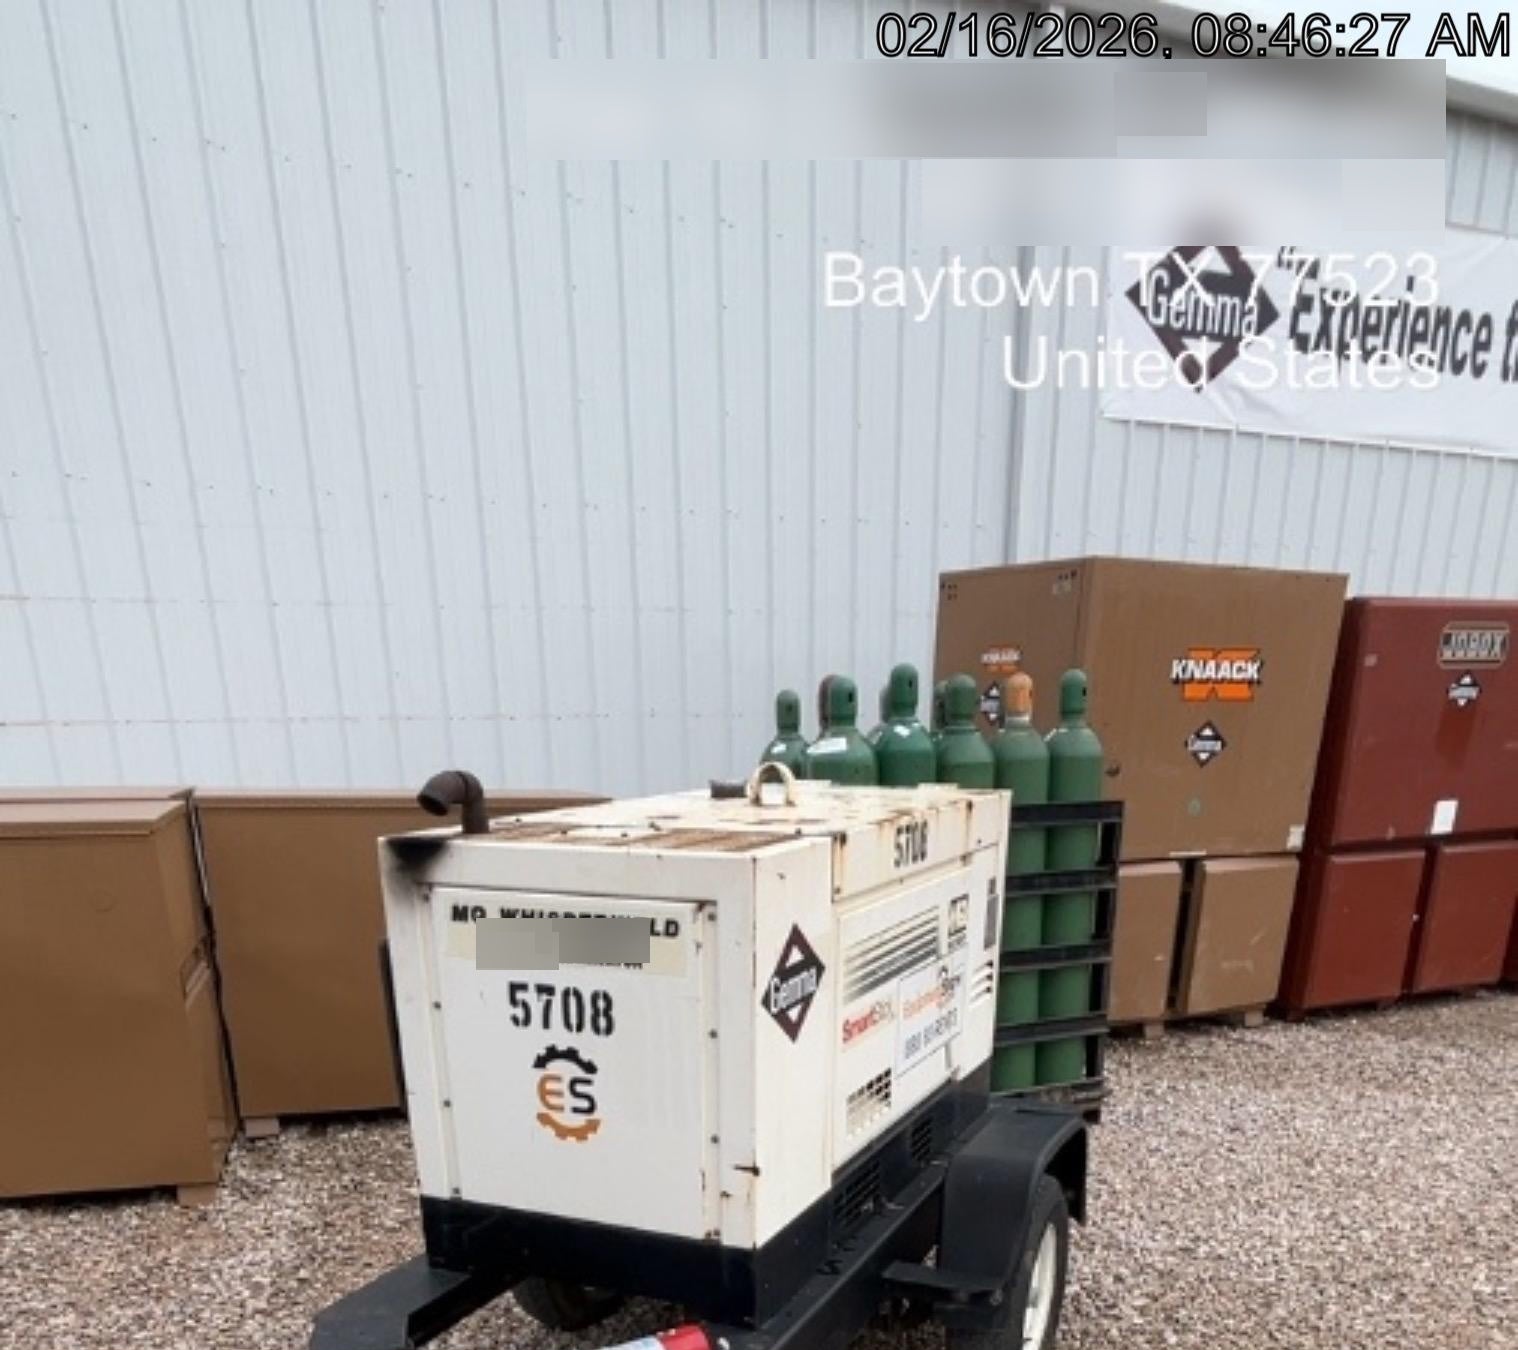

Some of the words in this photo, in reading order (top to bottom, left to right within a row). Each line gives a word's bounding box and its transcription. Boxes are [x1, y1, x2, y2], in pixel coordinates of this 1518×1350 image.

[1147, 267, 1258, 339] Gemma
[1171, 658, 1263, 682] KNAACK
[508, 981, 614, 1036] 5708
[537, 1074, 598, 1116] ES
